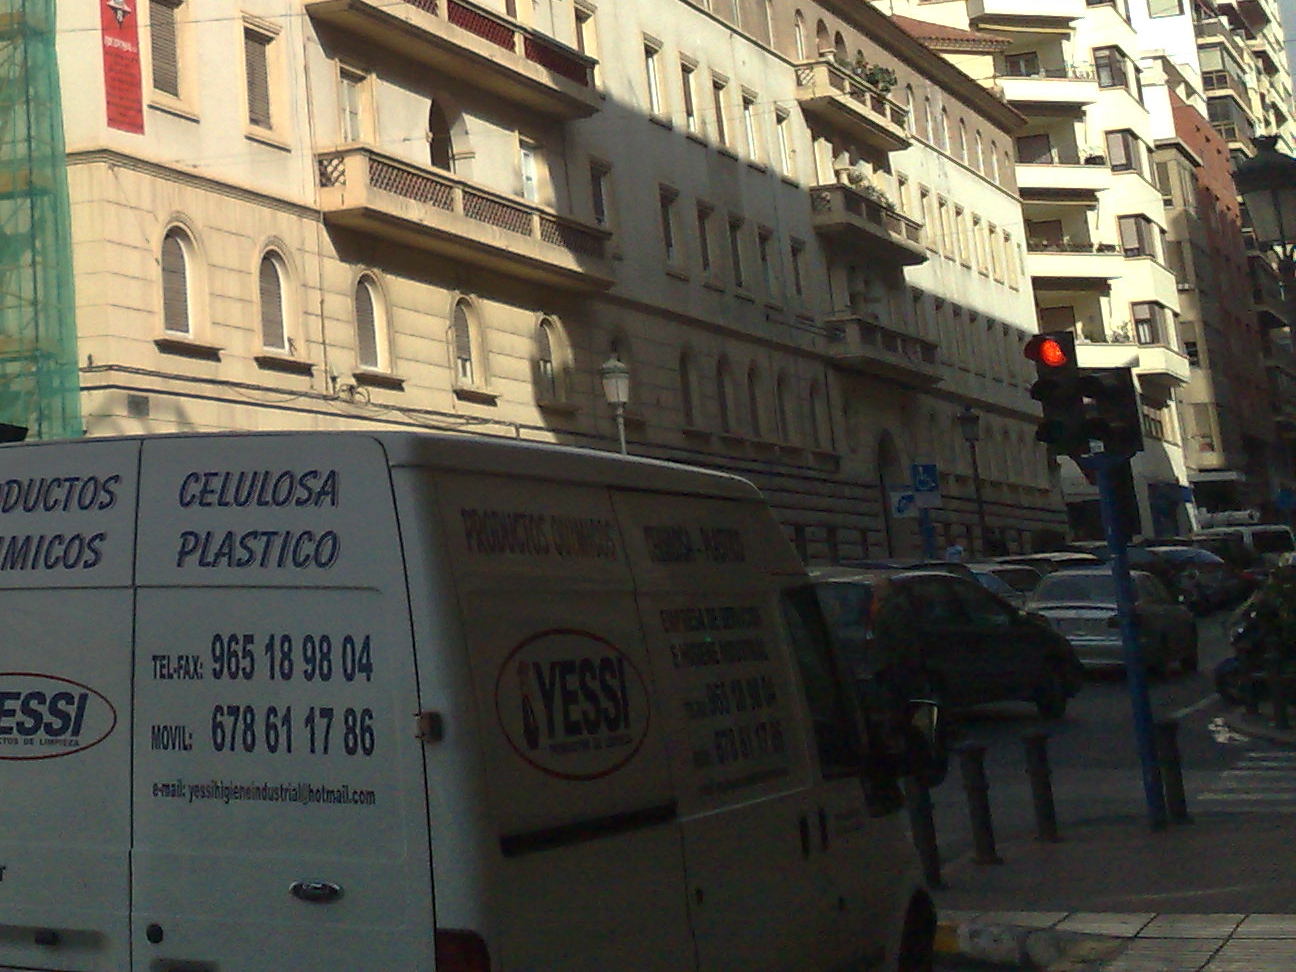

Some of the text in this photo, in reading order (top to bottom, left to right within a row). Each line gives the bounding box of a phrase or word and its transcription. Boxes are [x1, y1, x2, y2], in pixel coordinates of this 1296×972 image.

[179, 469, 340, 508] CELULOSA
[176, 529, 341, 570] PLASTICO
[152, 633, 374, 683] TEL-FAX: 965 18 98 04
[532, 656, 631, 739] YESSI
[151, 704, 375, 757] MOVIL: 678 61 17 86
